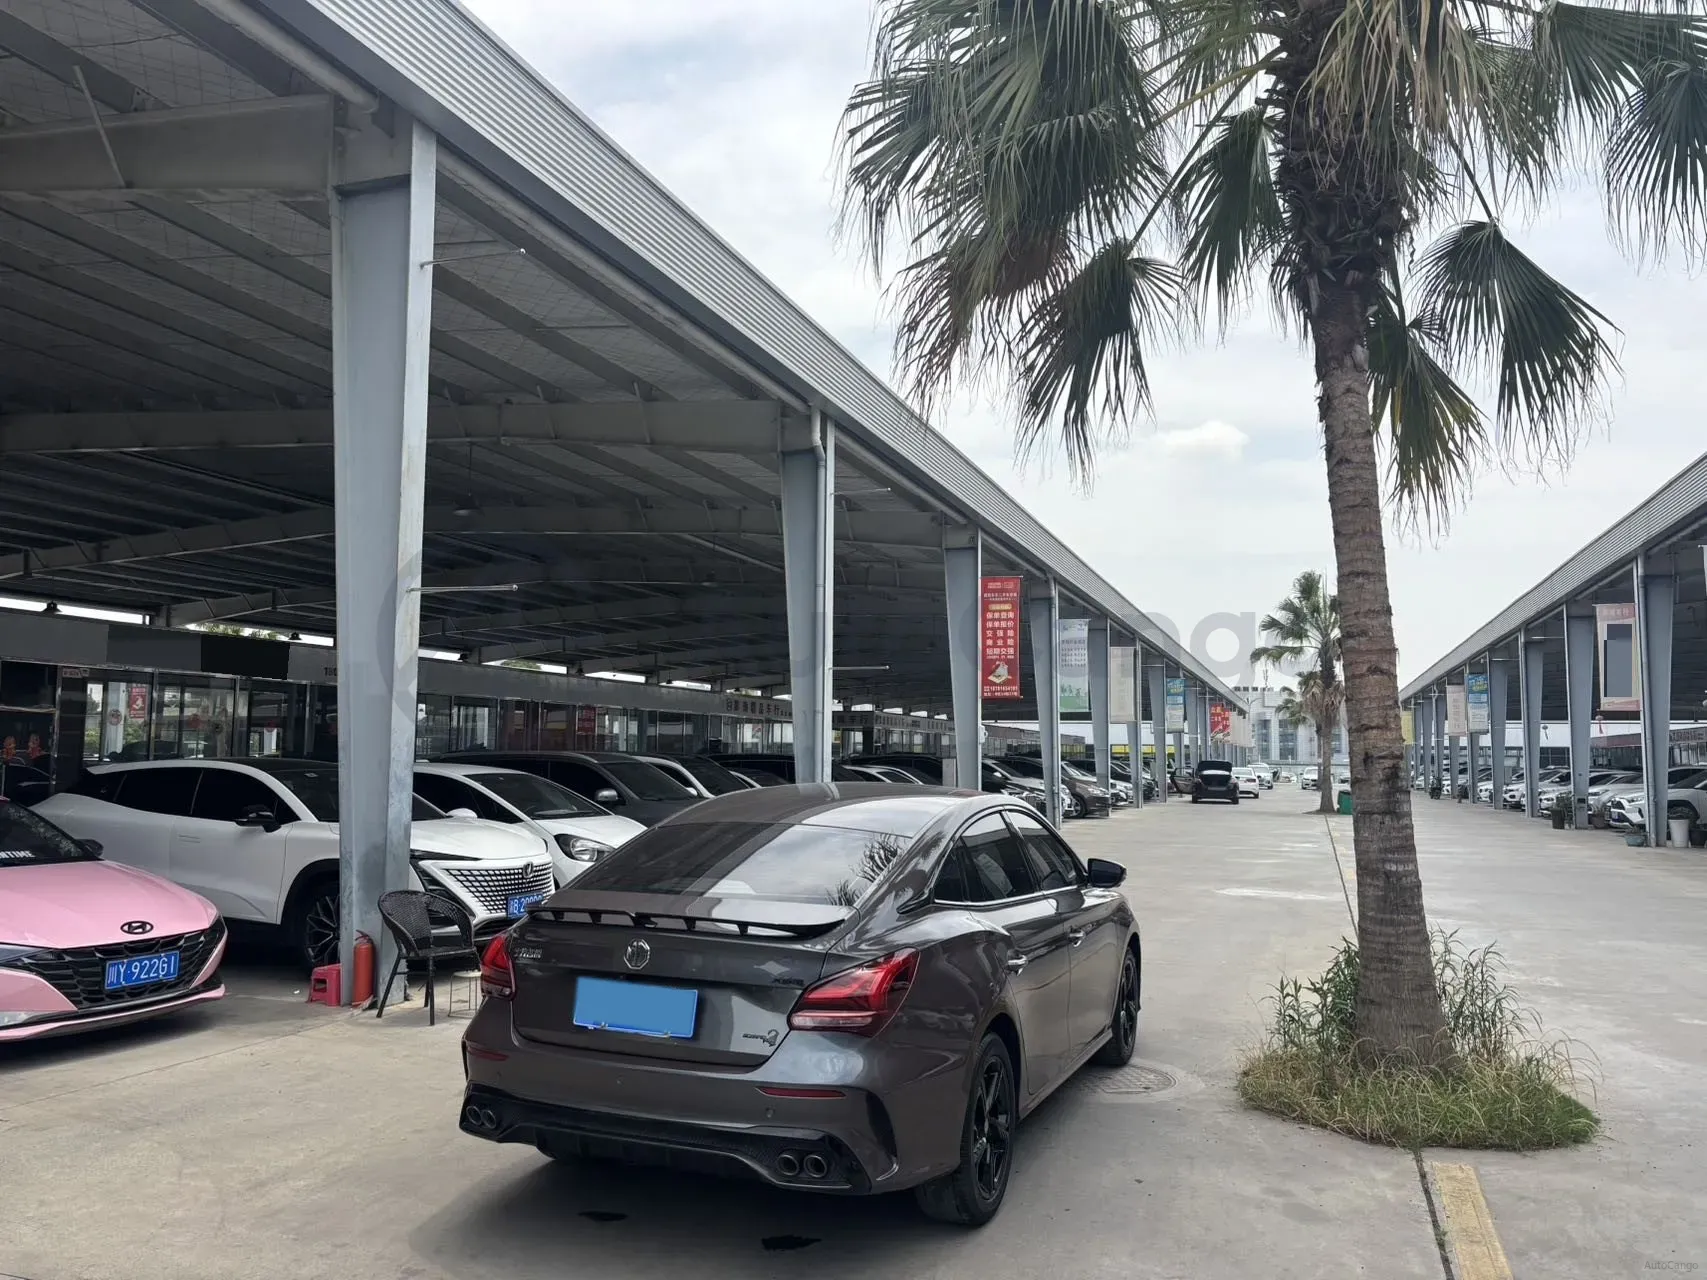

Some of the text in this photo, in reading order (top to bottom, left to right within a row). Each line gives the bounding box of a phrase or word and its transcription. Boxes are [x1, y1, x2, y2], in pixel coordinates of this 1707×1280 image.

[986, 611, 1015, 619] 保单查询
[986, 620, 1015, 629] 保单报价
[986, 647, 1015, 655] 短期交强
